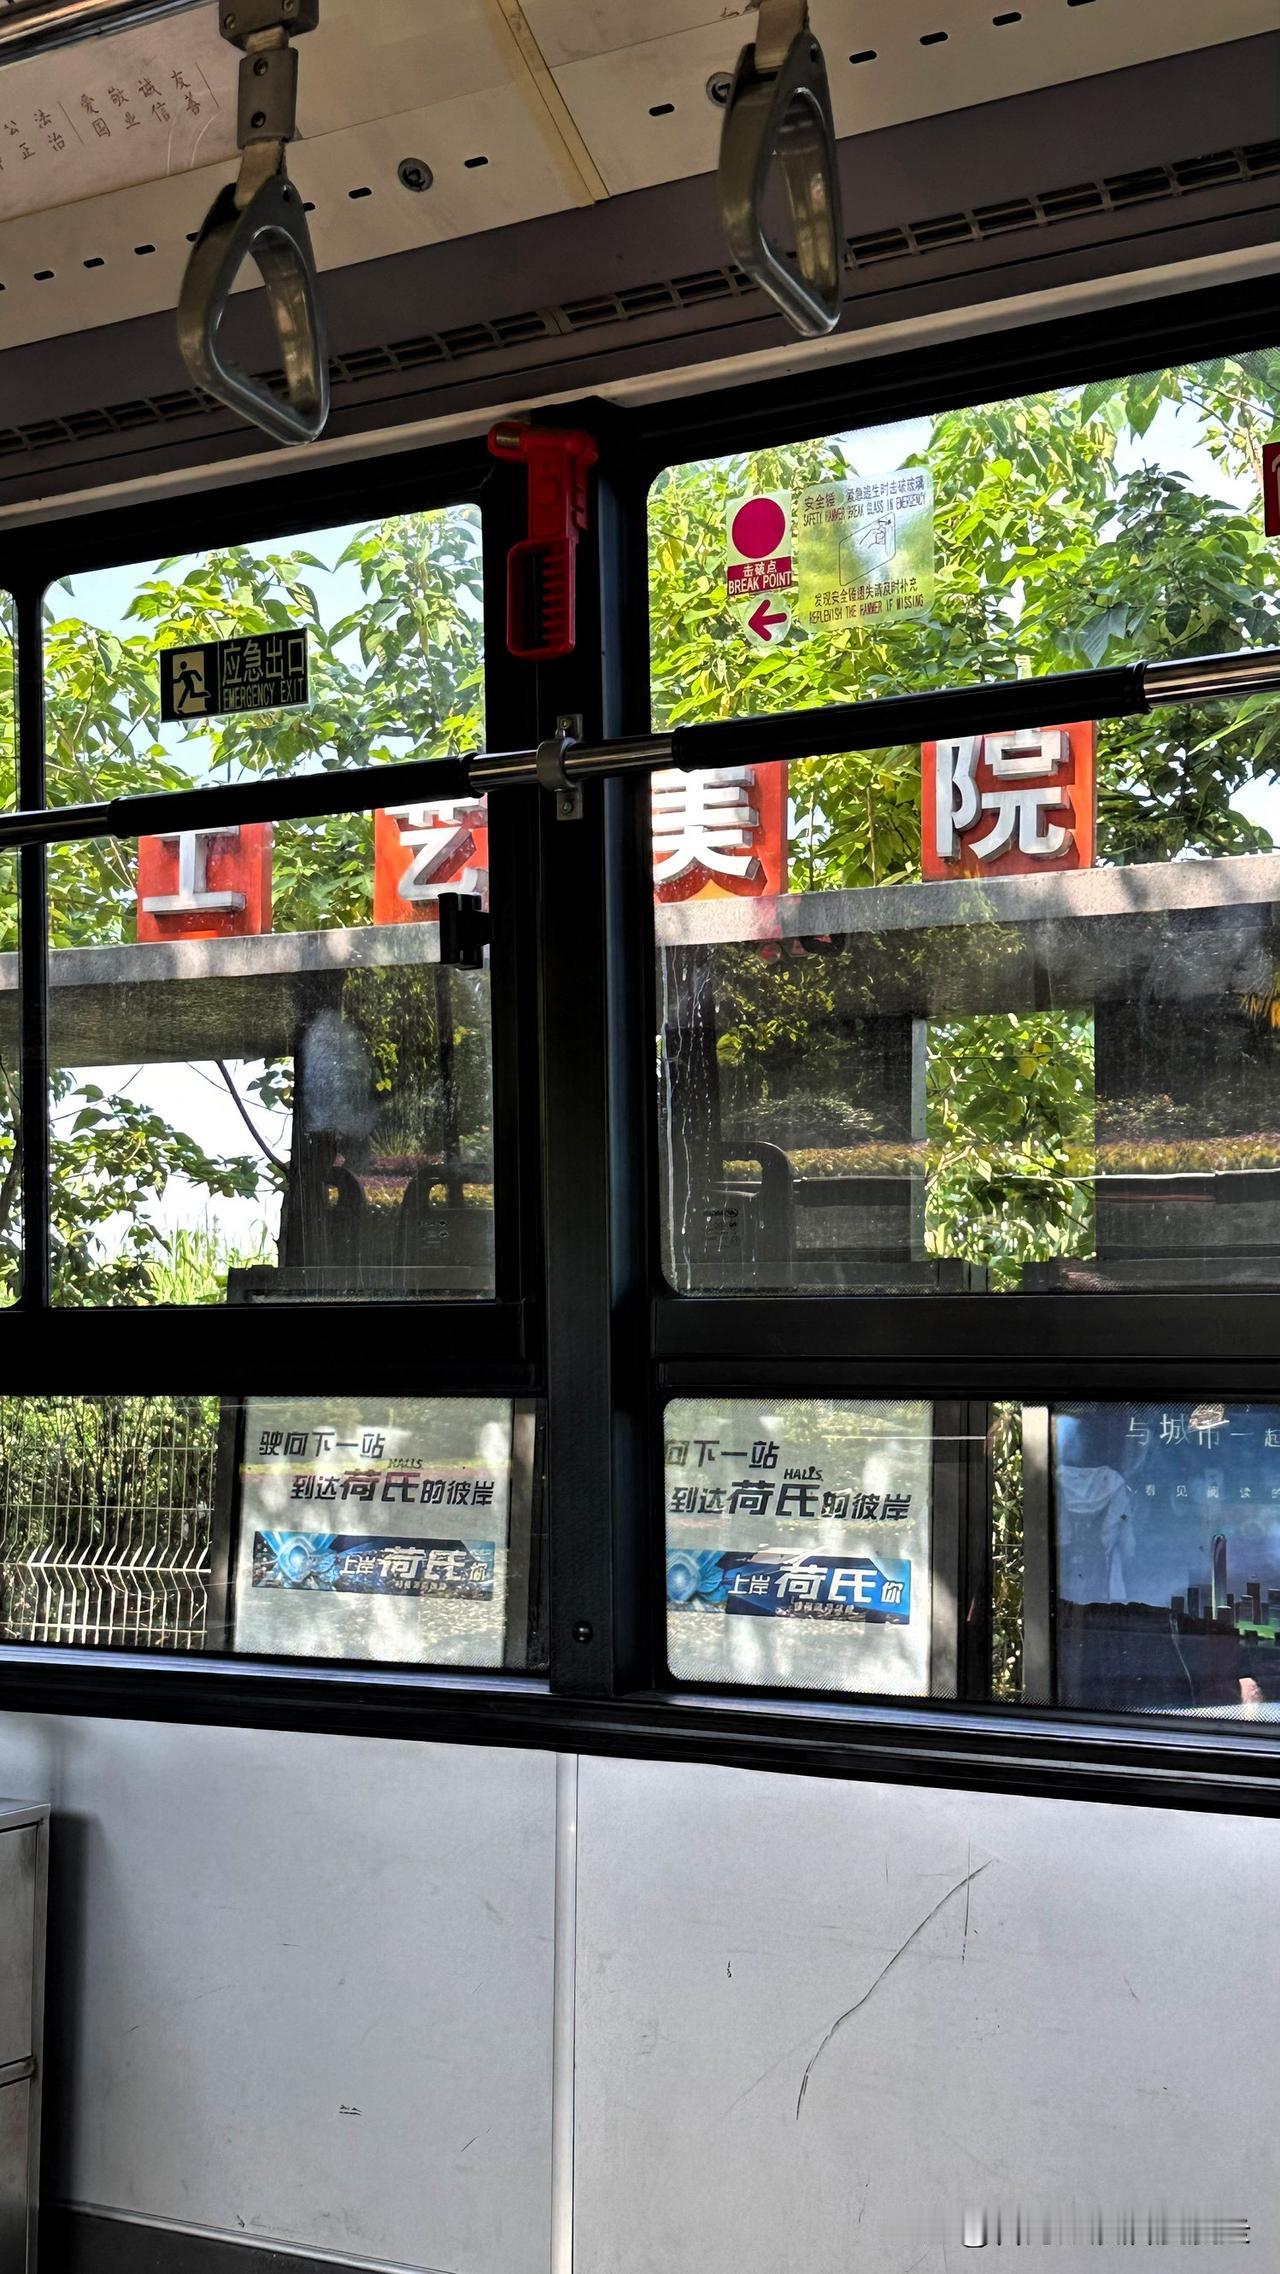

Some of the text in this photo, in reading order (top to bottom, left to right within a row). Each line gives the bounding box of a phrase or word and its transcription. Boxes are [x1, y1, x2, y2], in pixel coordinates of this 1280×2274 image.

[728, 571, 792, 595] BREAK POINT
[743, 560, 778, 578] 击破点
[222, 635, 305, 687] 应急出口
[223, 677, 305, 712] EMERGENCY EXIT
[258, 1430, 386, 1459] 驶向下一站
[290, 1468, 495, 1506] 到达荷氏的彼岸
[669, 1479, 912, 1521] 到达荷氏的彼岸
[728, 1564, 904, 1605] 上岸荷氏你
